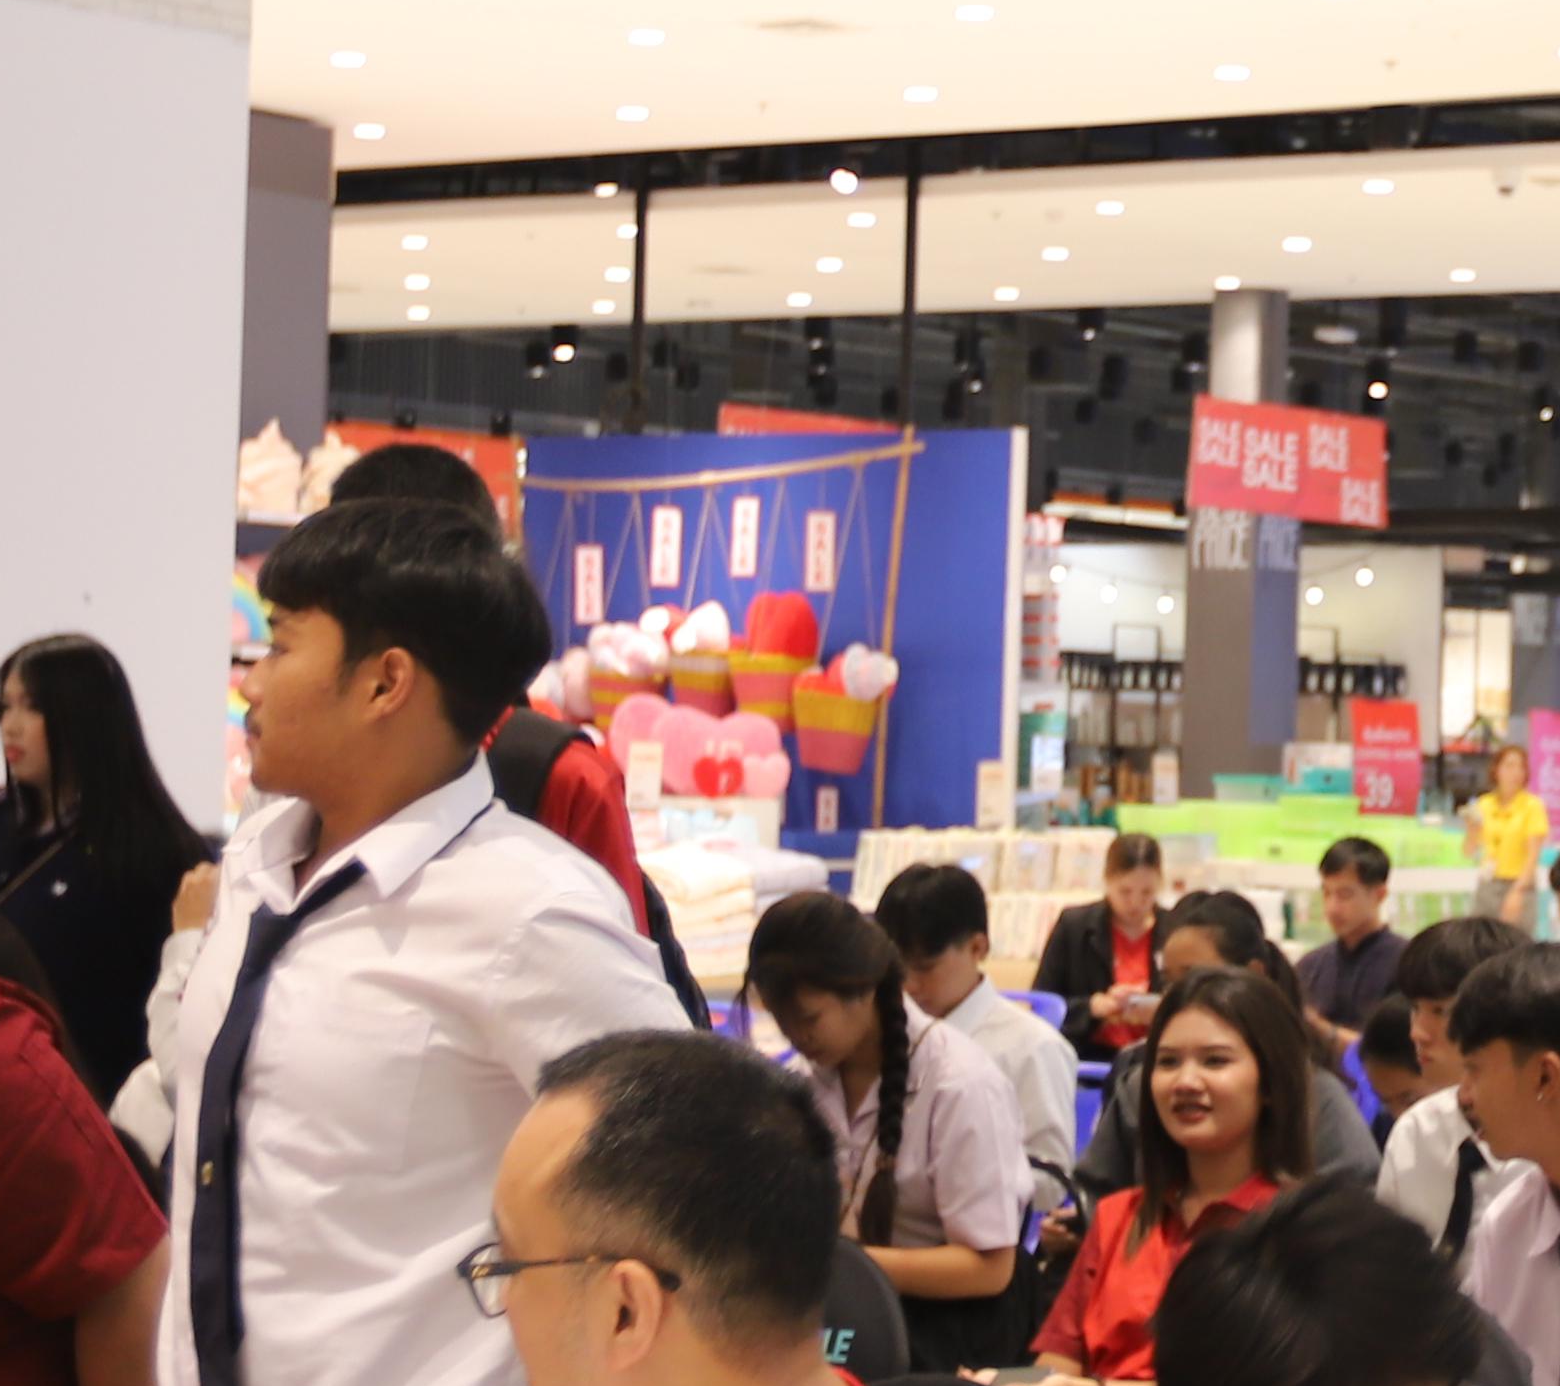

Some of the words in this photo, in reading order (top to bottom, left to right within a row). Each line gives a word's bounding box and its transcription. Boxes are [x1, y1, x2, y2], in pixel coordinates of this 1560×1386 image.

[1243, 427, 1299, 460] SALE
[1242, 456, 1299, 493] SALE
[1364, 773, 1394, 808] 39
